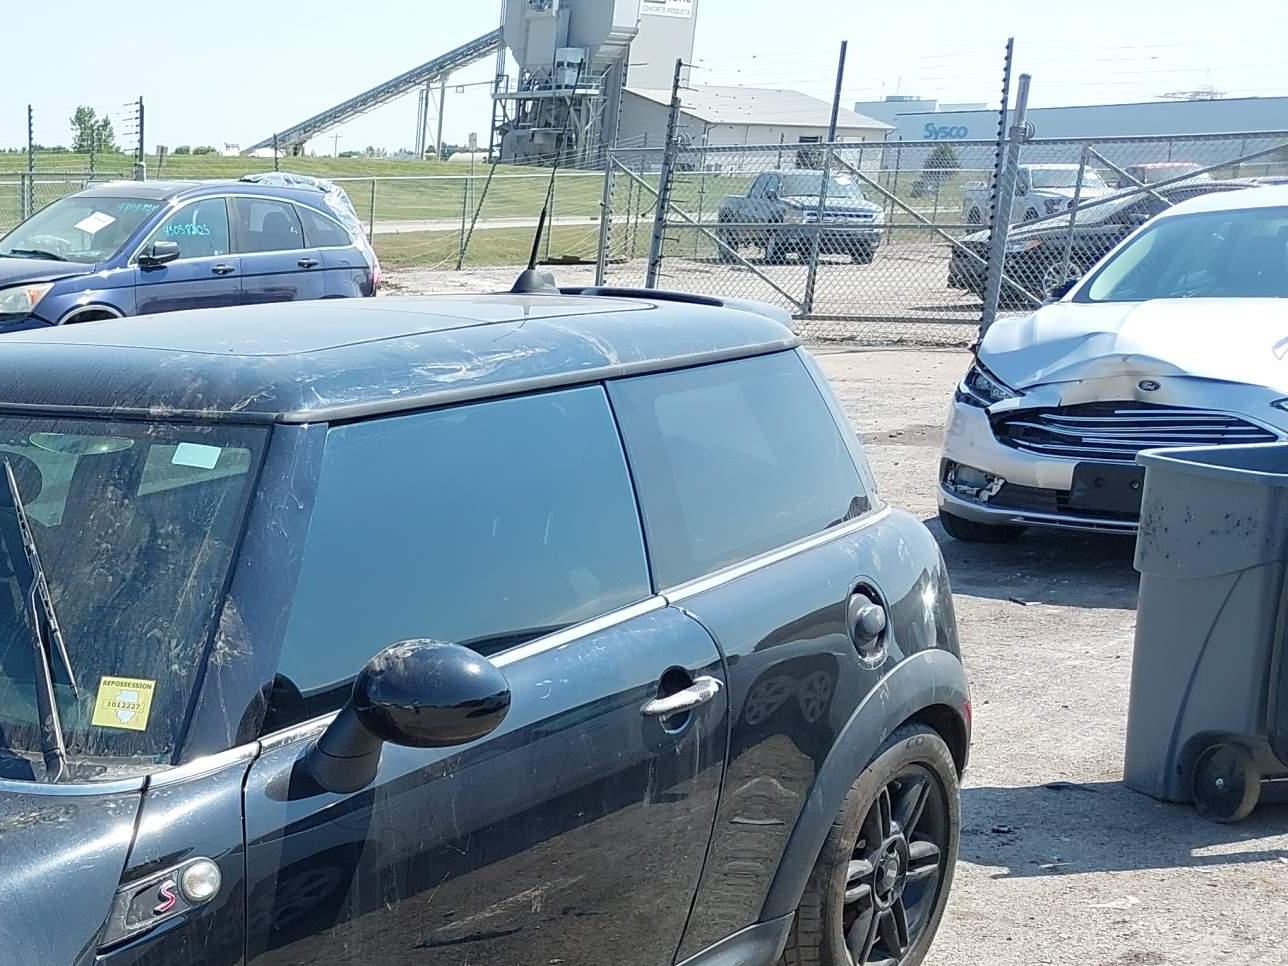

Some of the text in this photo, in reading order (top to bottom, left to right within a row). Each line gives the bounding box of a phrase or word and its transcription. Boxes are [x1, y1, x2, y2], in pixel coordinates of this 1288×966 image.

[923, 122, 968, 140] Sysco
[103, 679, 152, 690] REPOSSESSION
[153, 879, 176, 916] S
